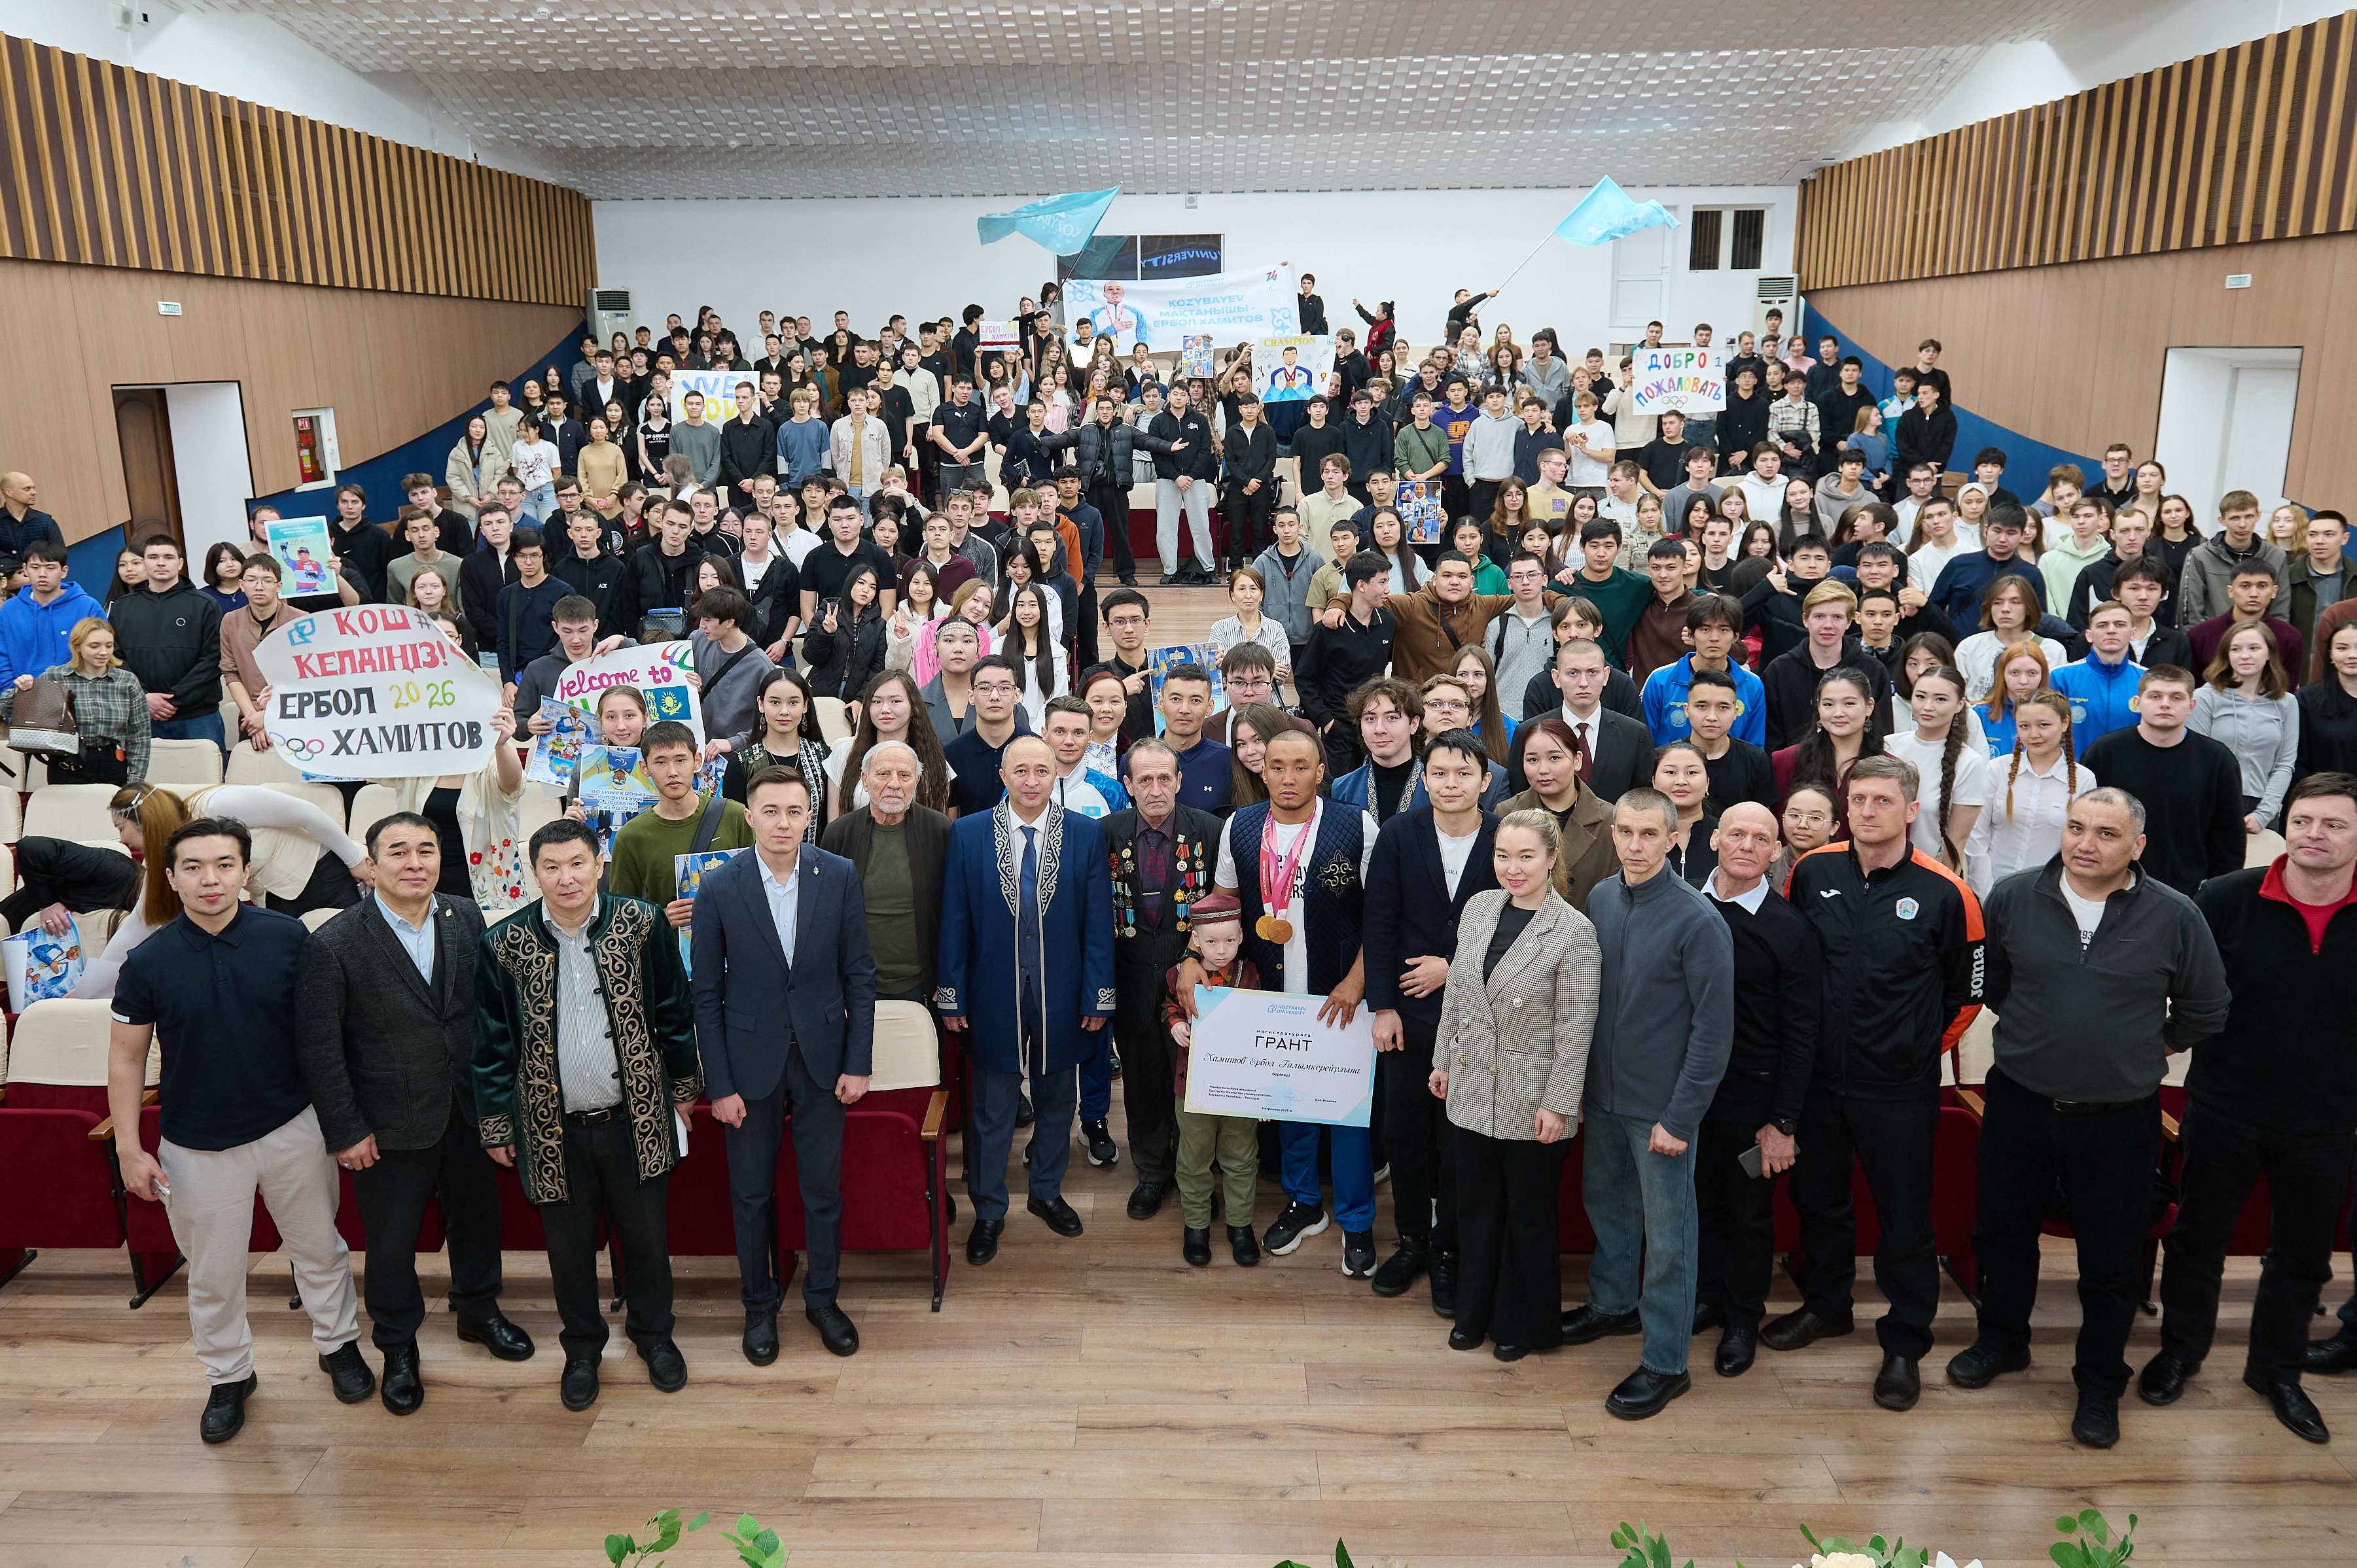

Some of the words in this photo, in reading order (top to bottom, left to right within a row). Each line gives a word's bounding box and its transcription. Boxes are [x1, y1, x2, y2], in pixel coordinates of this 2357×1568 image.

[1168, 294, 1245, 307] KOZYBAYEV
[161, 304, 179, 313] ЫХОД
[1159, 305, 1249, 318] МАҚТАНЫШЫ
[1153, 319, 1196, 328] ЕРБОЛ
[1199, 314, 1263, 325] ХАМИТОВ
[980, 325, 1001, 334] ЕРБОЛ
[1264, 337, 1316, 347] CHAMPION
[1648, 352, 1707, 372] ДОБРО
[1635, 377, 1722, 407] ПОЖАЛОВАТЬ
[332, 608, 412, 638] ҚОШ
[648, 665, 672, 684] to
[278, 686, 378, 720] ЕРБОЛ
[330, 721, 483, 756] ХАМИТОВ
[1255, 1036, 1313, 1052] ГРАНТ
[1203, 1053, 1247, 1065] Хамитов
[1249, 1057, 1275, 1068] Ербол
